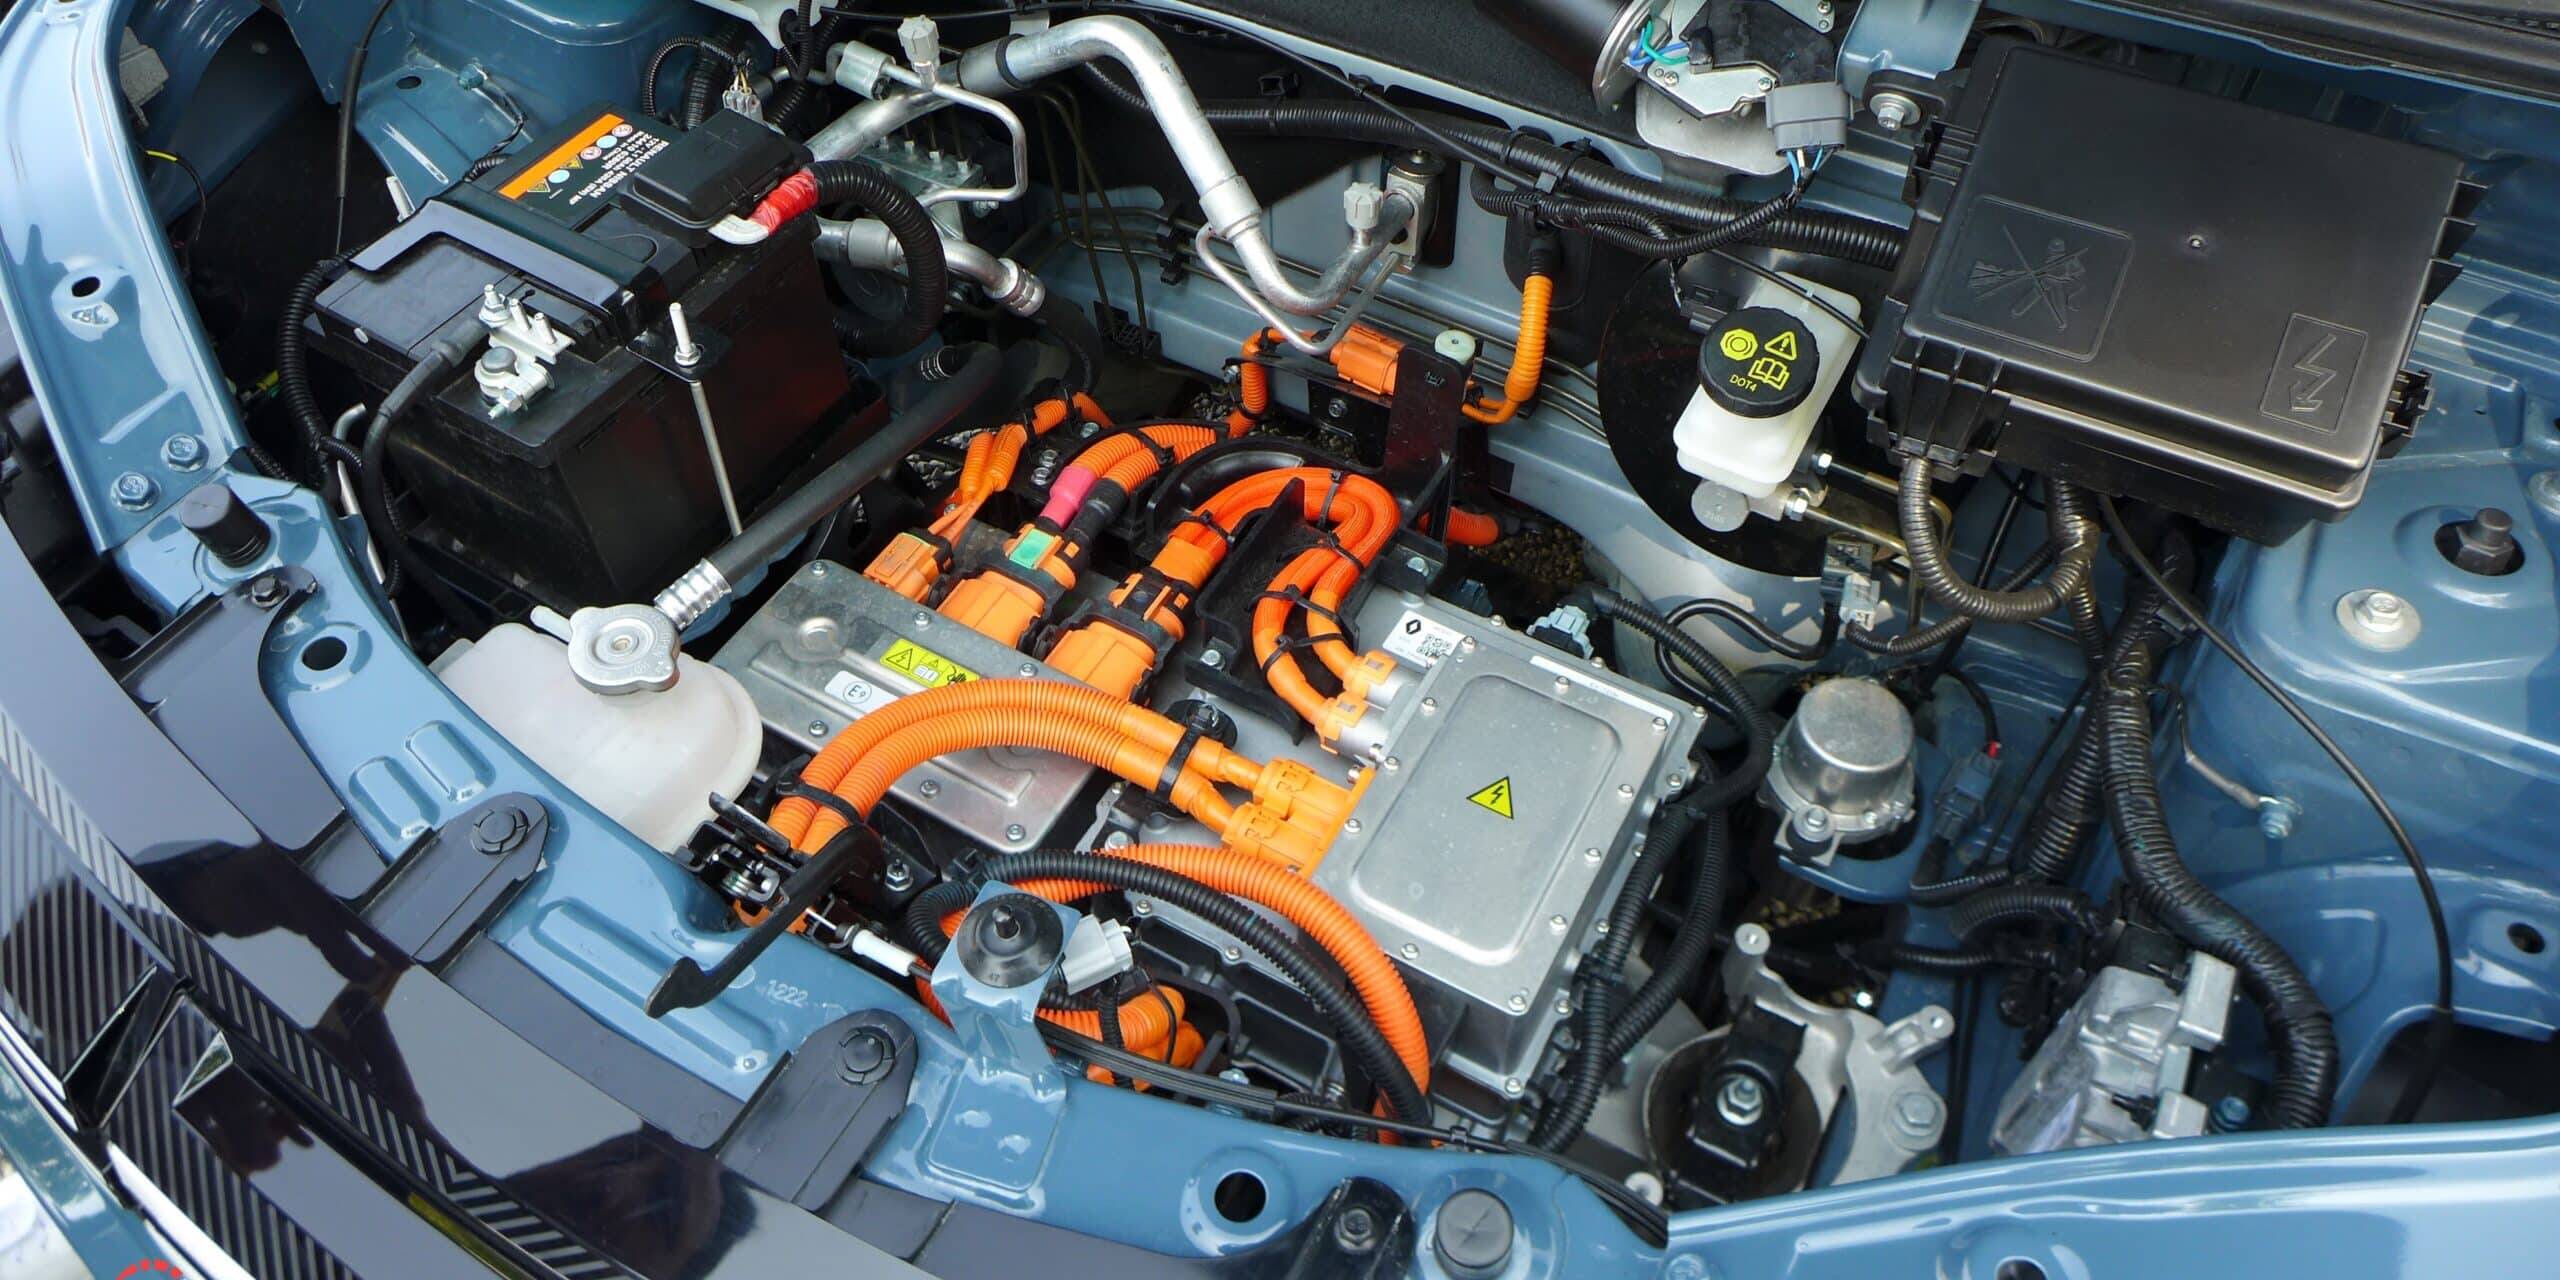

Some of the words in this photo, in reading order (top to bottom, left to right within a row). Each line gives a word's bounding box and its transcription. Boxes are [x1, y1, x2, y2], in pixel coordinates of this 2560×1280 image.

[643, 137, 660, 148] 12V
[624, 139, 670, 172] RENAULT
[589, 170, 628, 198] NISSAN
[1730, 374, 1758, 392] DOT4
